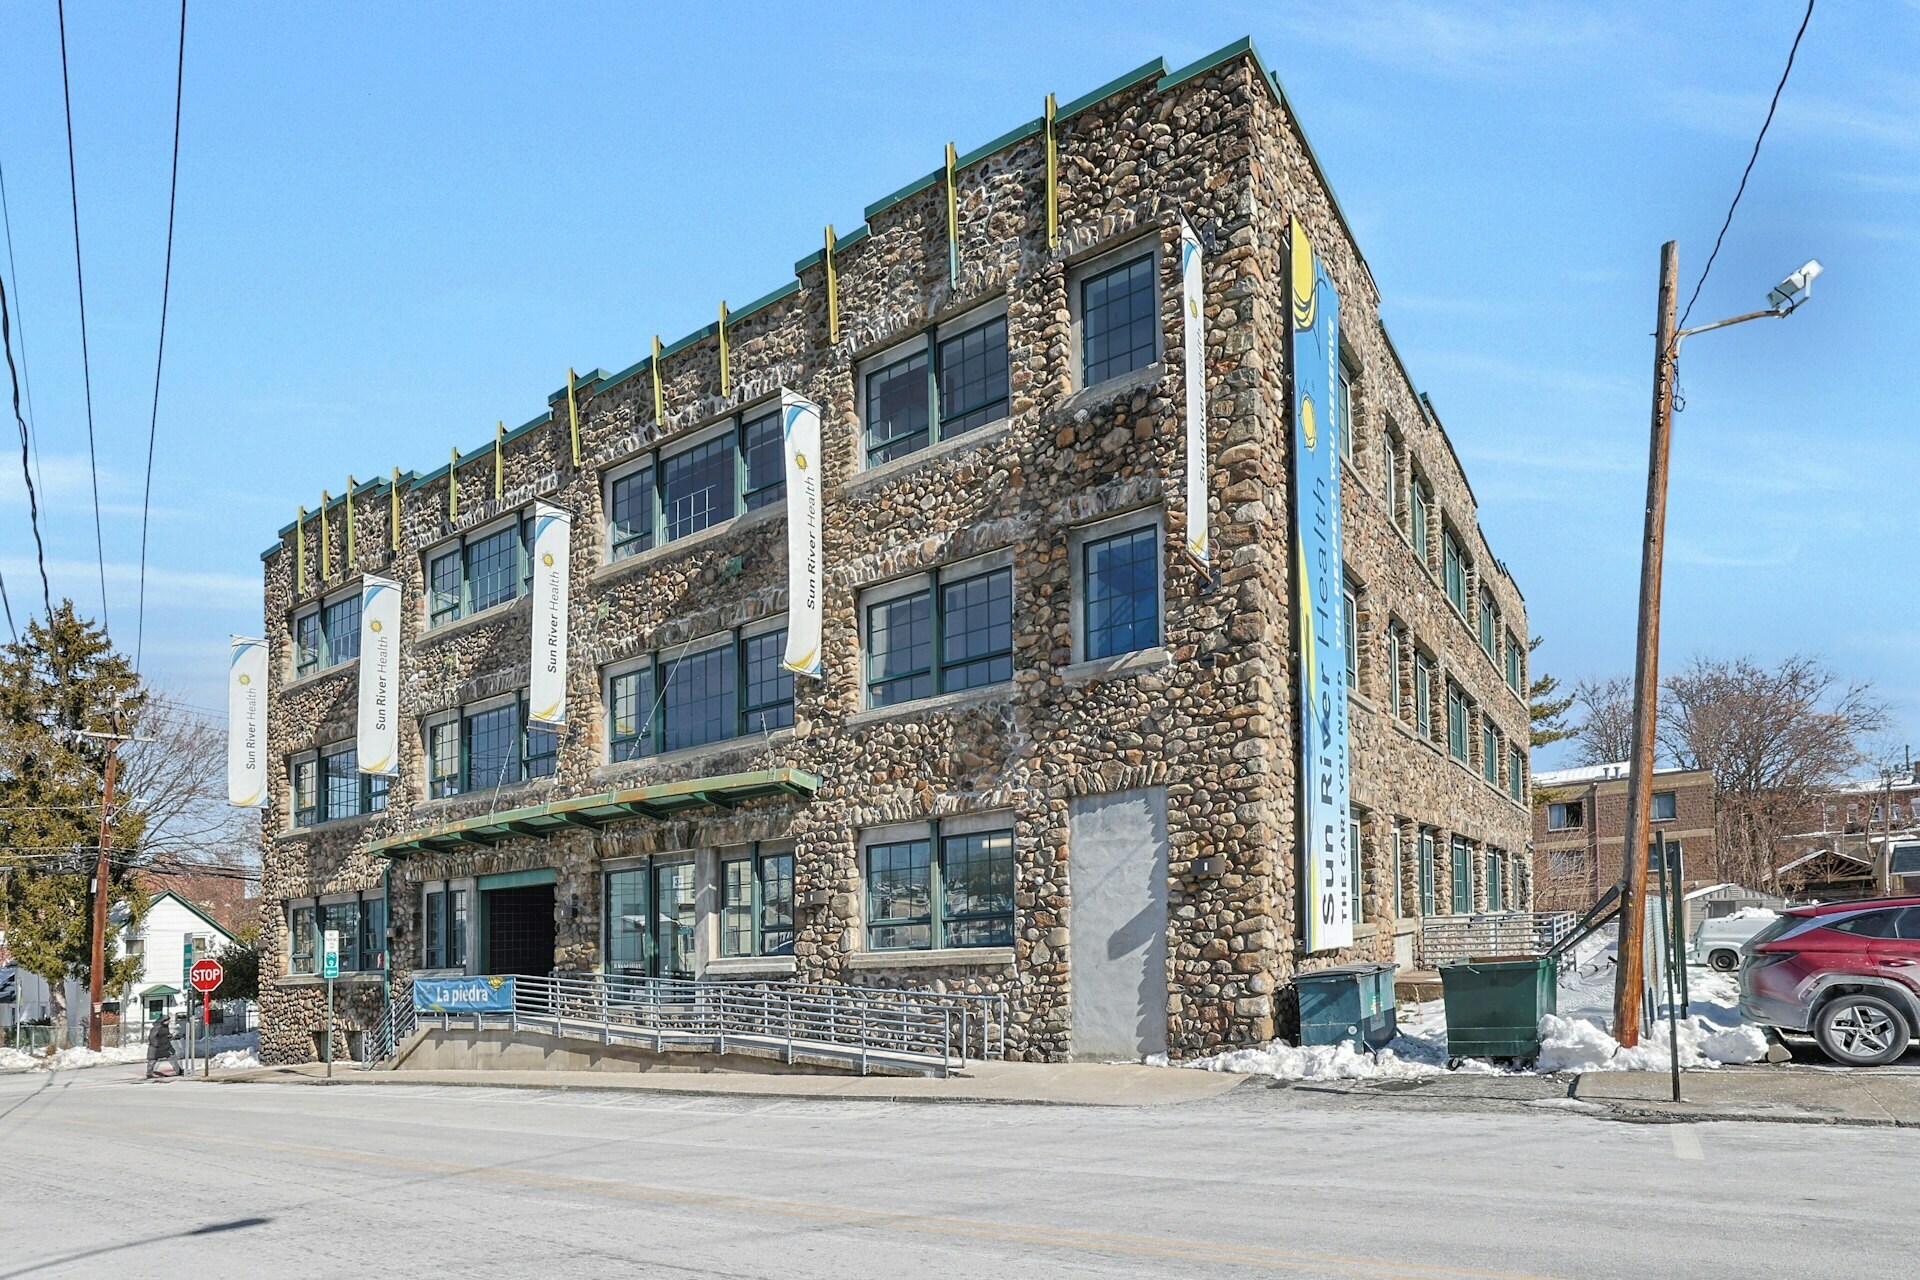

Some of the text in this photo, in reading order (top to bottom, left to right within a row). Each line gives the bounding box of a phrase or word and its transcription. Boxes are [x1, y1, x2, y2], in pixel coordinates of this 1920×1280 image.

[1196, 328, 1204, 389] Health
[1327, 315, 1342, 651] THE RESPECT YOU DESERVE
[804, 476, 816, 610] Sun River Health
[547, 571, 560, 674] Sun River Health
[246, 687, 257, 770] Sun River Health
[376, 636, 389, 731] Sun River Health
[1312, 476, 1335, 926] Sun River Health
[192, 968, 221, 982] STOP
[436, 984, 489, 1006] La piedra
